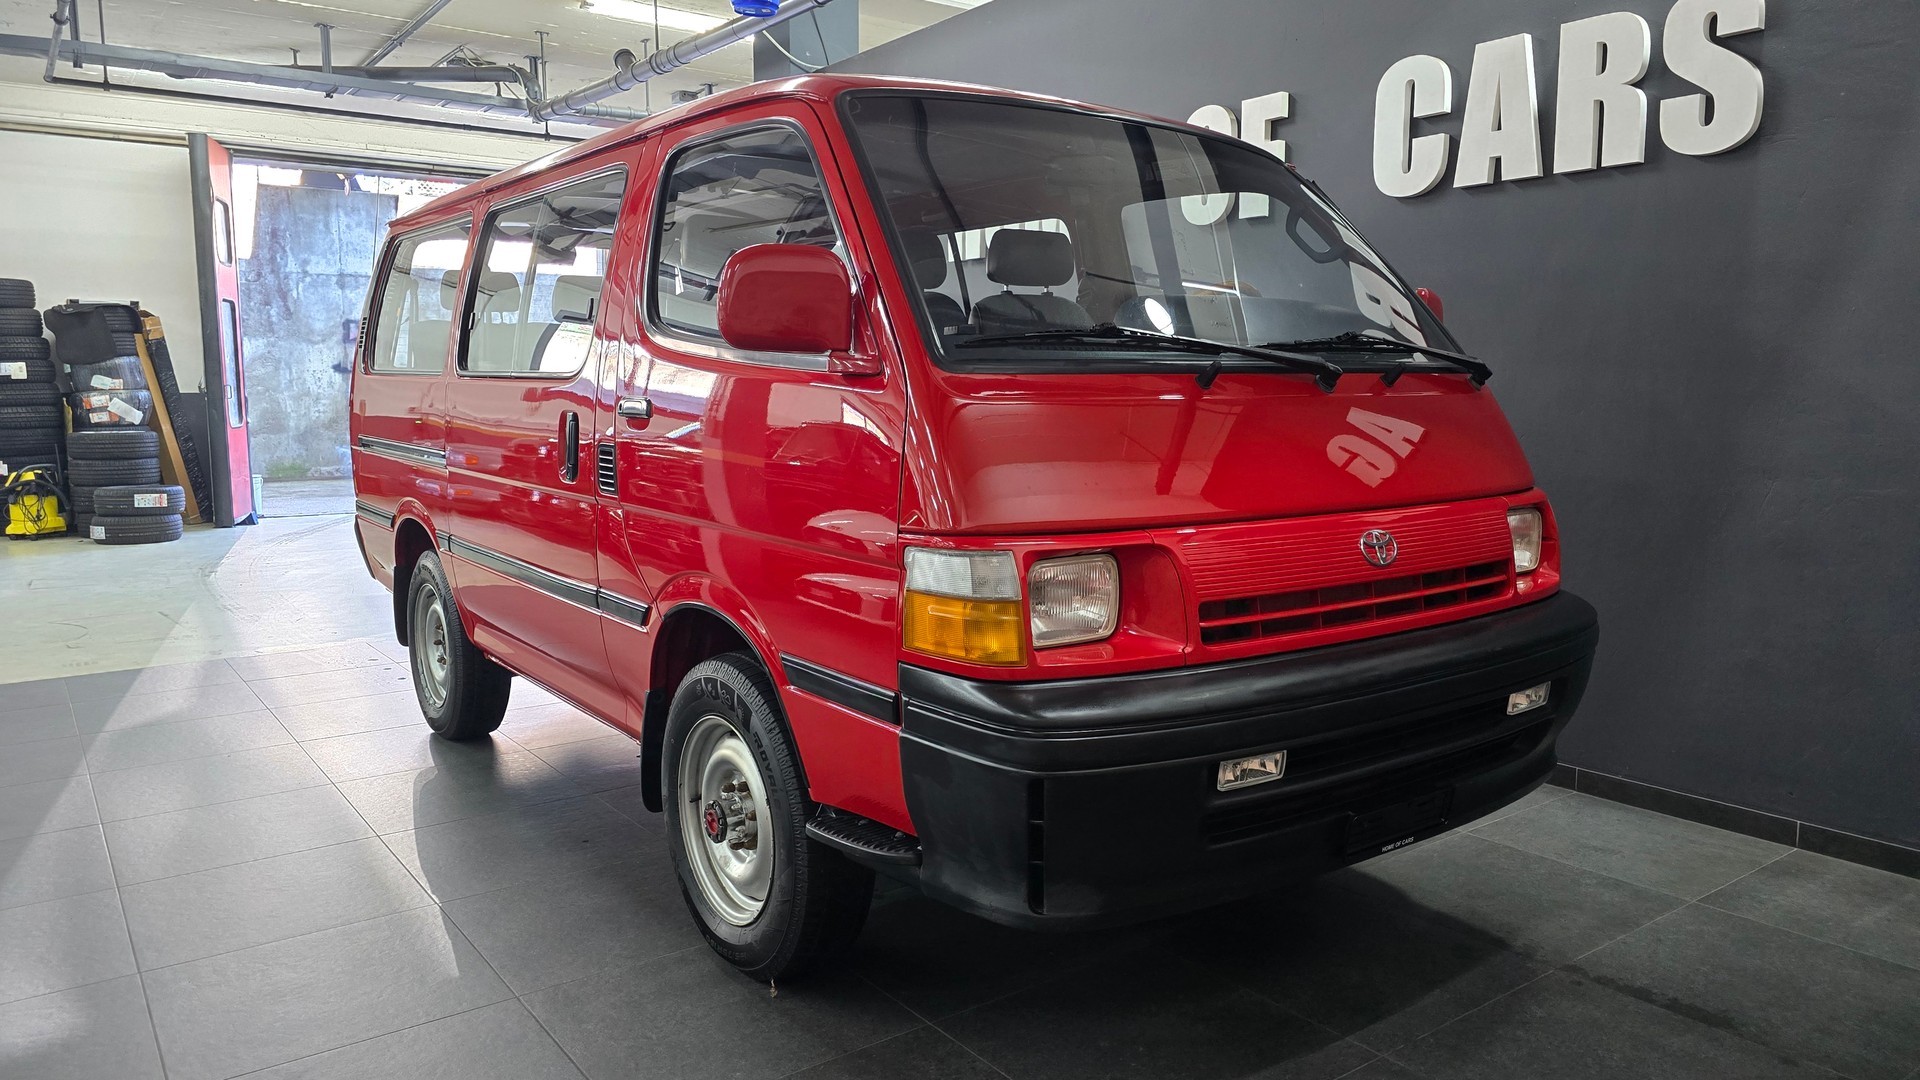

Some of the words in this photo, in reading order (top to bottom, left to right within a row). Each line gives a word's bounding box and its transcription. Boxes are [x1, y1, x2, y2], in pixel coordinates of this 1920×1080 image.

[1373, 0, 1766, 198] CARS
[1381, 843, 1395, 853] HOME
[1395, 840, 1402, 848] OF
[1402, 836, 1415, 845] CARS
